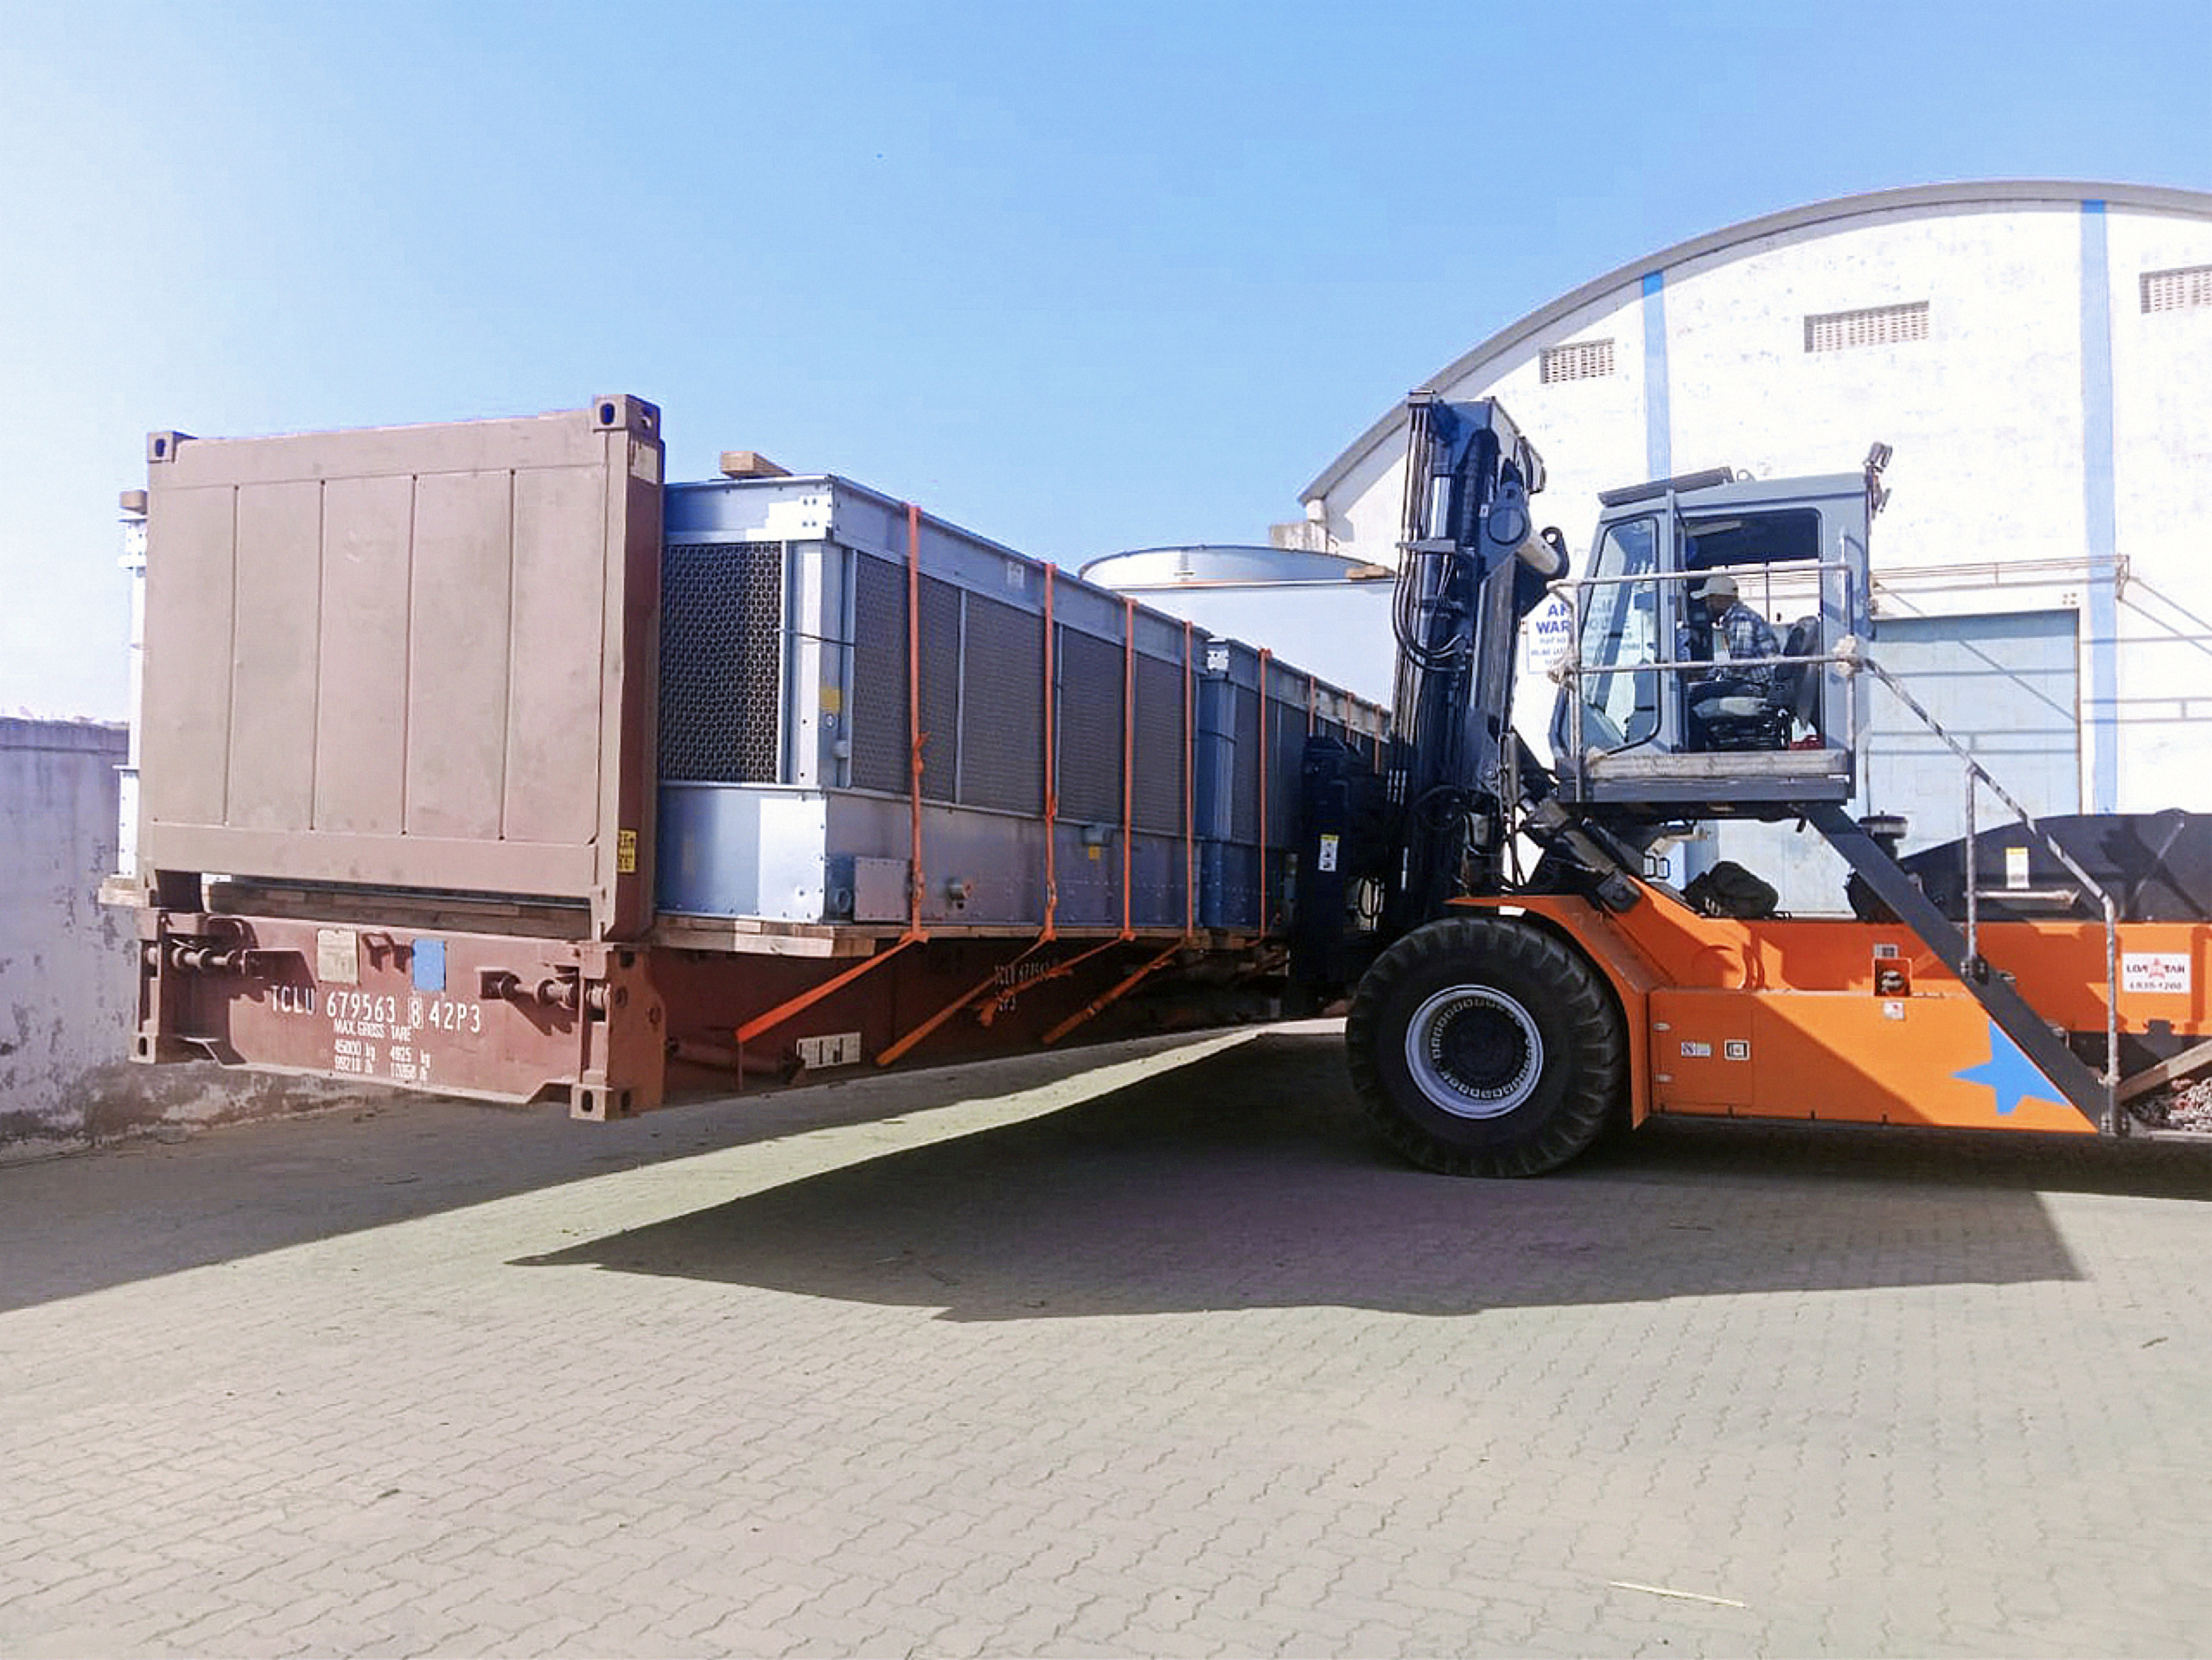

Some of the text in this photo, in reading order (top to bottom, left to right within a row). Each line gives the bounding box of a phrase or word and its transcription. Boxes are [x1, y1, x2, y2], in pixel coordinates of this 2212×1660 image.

[271, 986, 481, 1032] TCLU 679563 8 42P3
[391, 1025, 412, 1042] TARE
